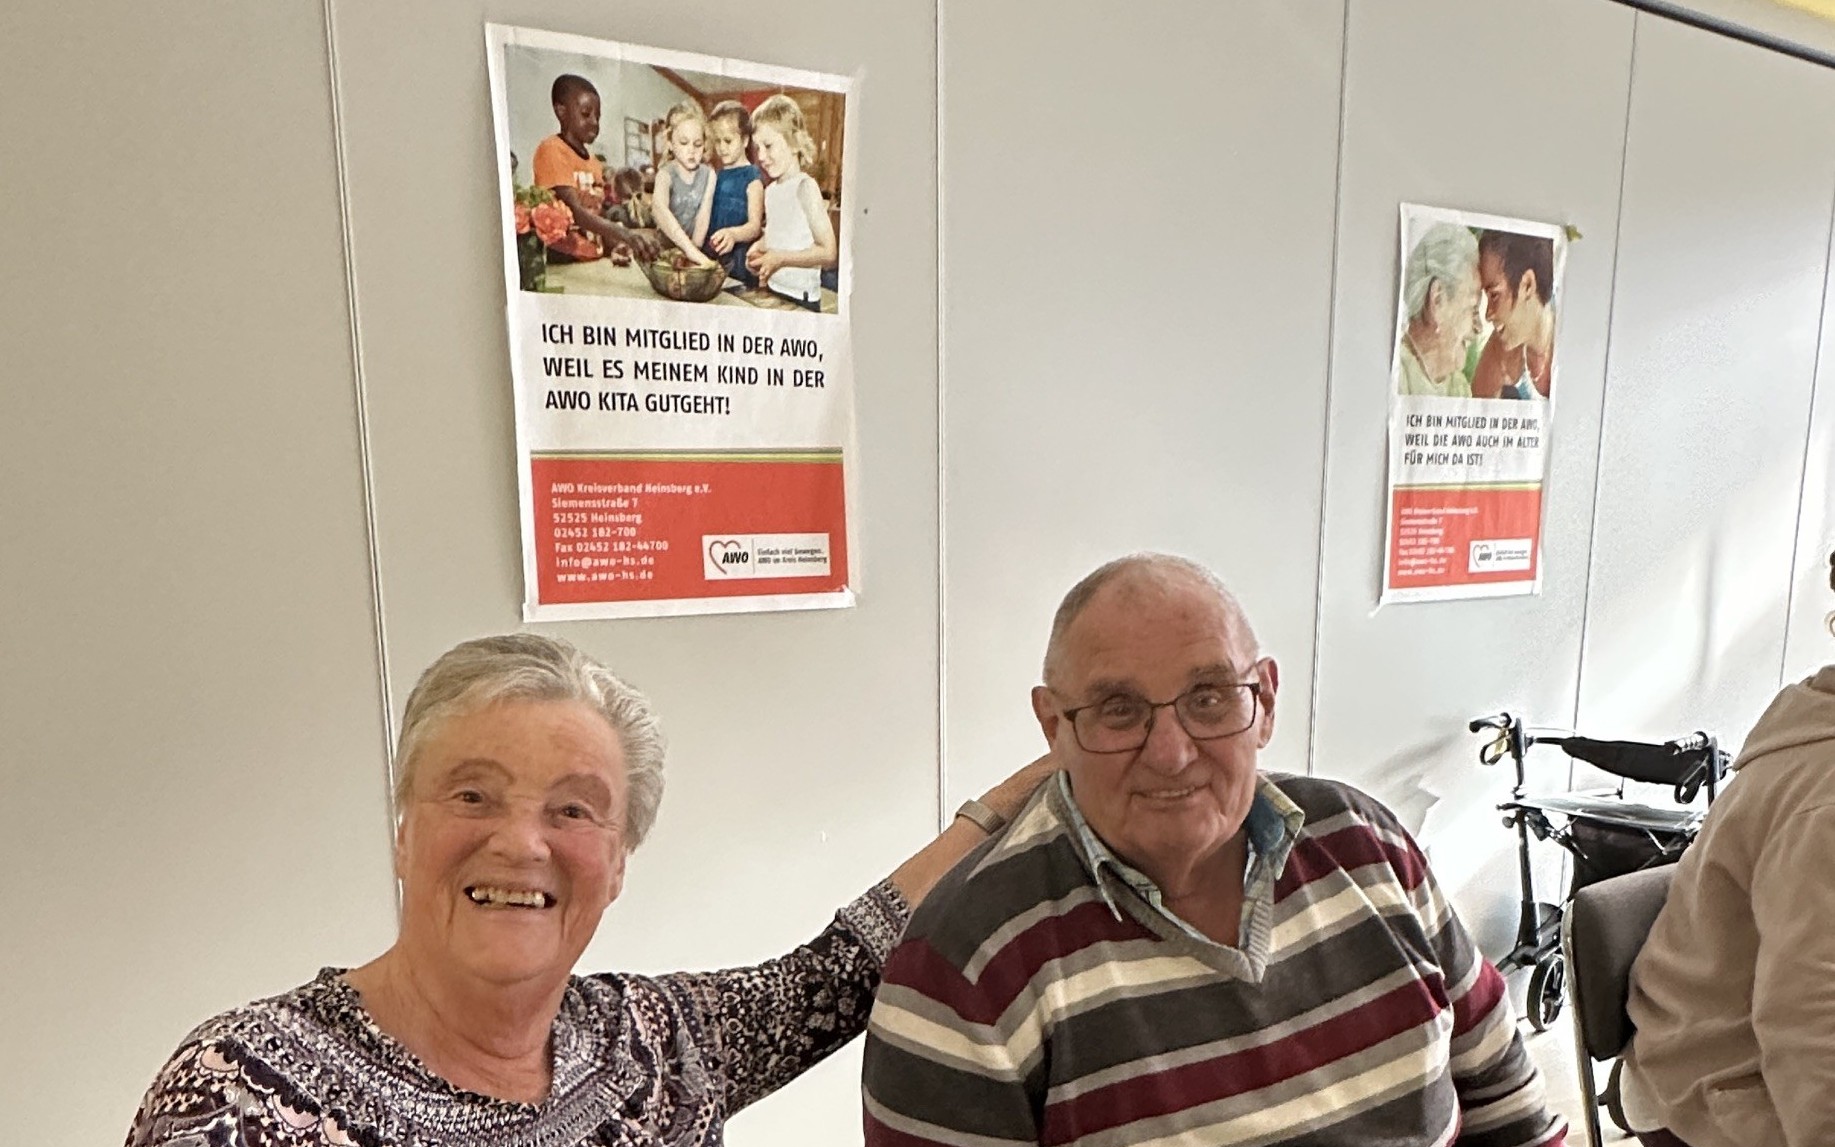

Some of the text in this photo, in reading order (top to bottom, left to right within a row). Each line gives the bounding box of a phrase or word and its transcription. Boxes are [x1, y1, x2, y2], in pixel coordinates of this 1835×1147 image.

[542, 323, 824, 362] ICH BIN MITGLIED IN DER AWO,
[543, 357, 825, 388] WEIL ES MEINEM KIND IN DER
[545, 390, 731, 415] AWO KITA GUTGEHT!
[1405, 434, 1429, 447] WEIL
[1433, 434, 1448, 447] DIE
[1452, 435, 1472, 447] AWO
[1476, 435, 1499, 447] AUCH
[1452, 453, 1463, 465] DA
[551, 483, 574, 494] AWO
[577, 483, 643, 494] Kreisverband
[645, 483, 693, 495] Heinsberg
[632, 498, 638, 508] 7
[553, 513, 643, 524] 52525 Heinsberg
[554, 527, 588, 538] 02452
[555, 542, 573, 553] Fax
[576, 542, 609, 552] 02452
[556, 555, 655, 568] info@awo-hs.de
[722, 551, 749, 564] AWO
[557, 570, 653, 582] www.awo-hs.de
